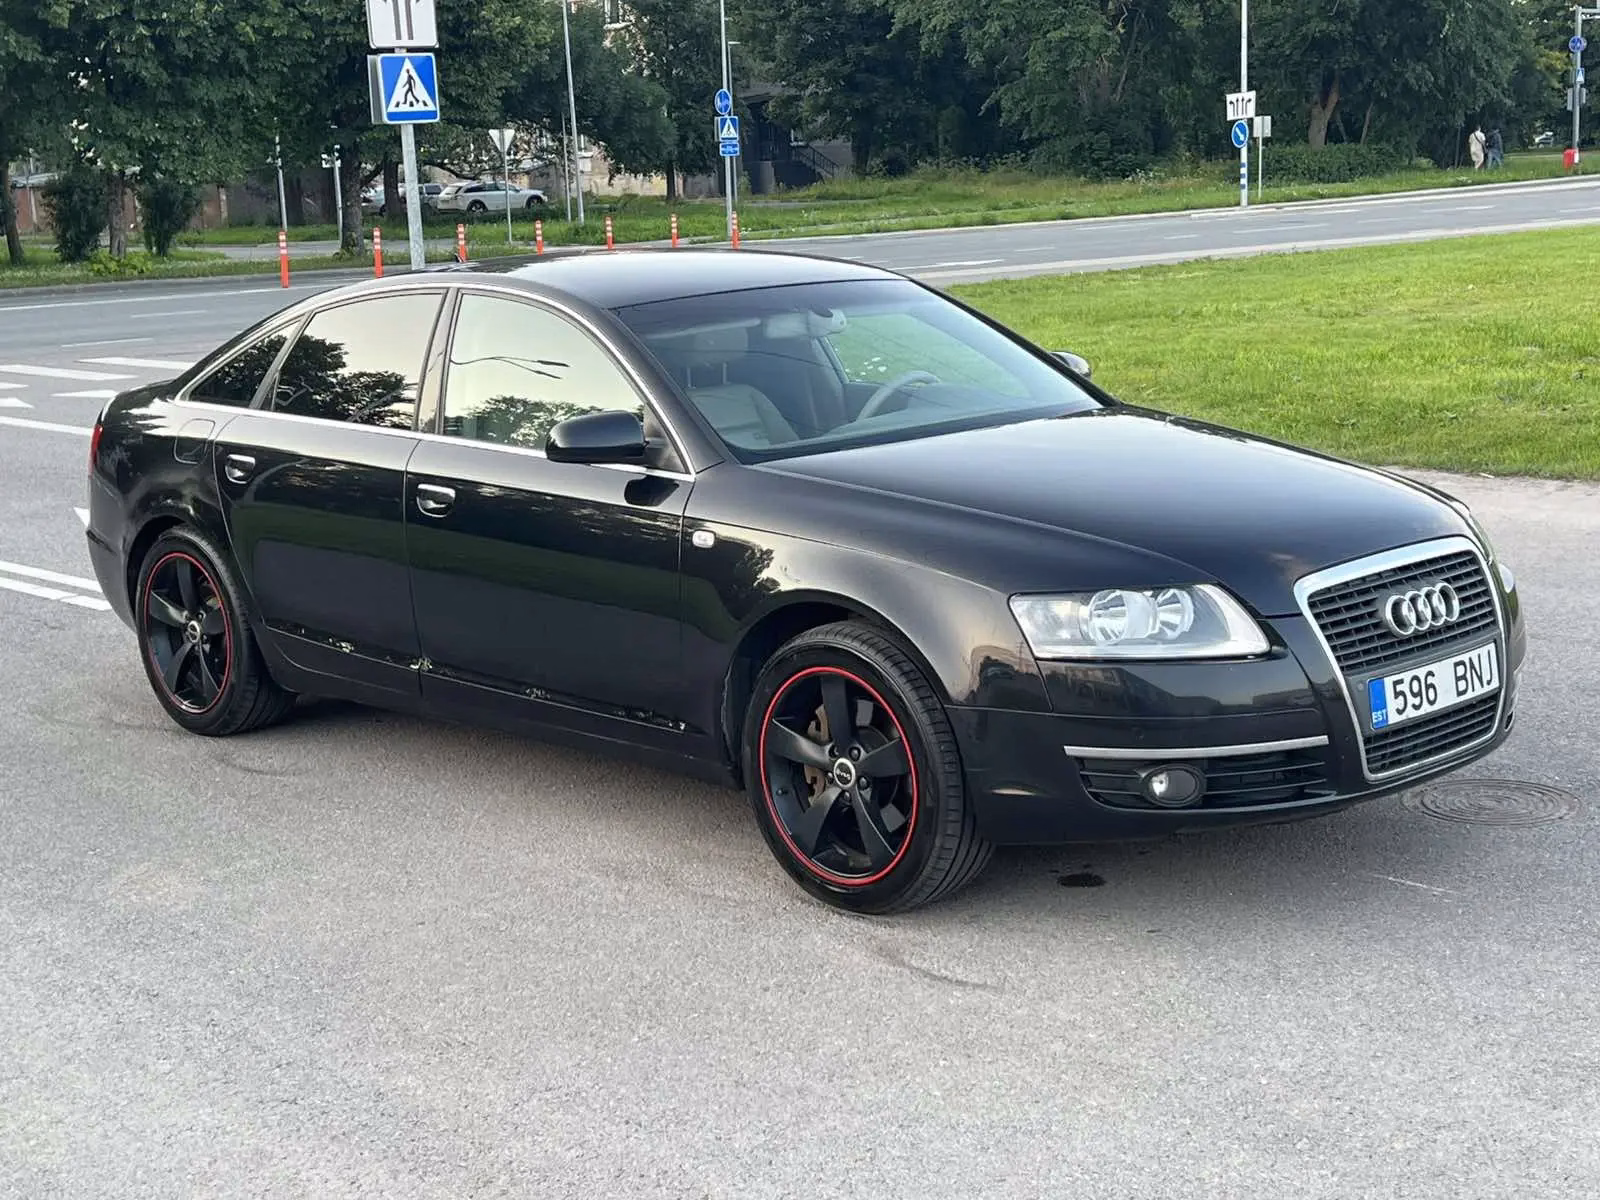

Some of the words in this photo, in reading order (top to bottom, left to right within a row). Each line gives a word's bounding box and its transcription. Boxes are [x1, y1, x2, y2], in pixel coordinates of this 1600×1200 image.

[1392, 670, 1438, 716] 596
[1453, 649, 1493, 697] BNJ
[1372, 709, 1387, 723] EST
